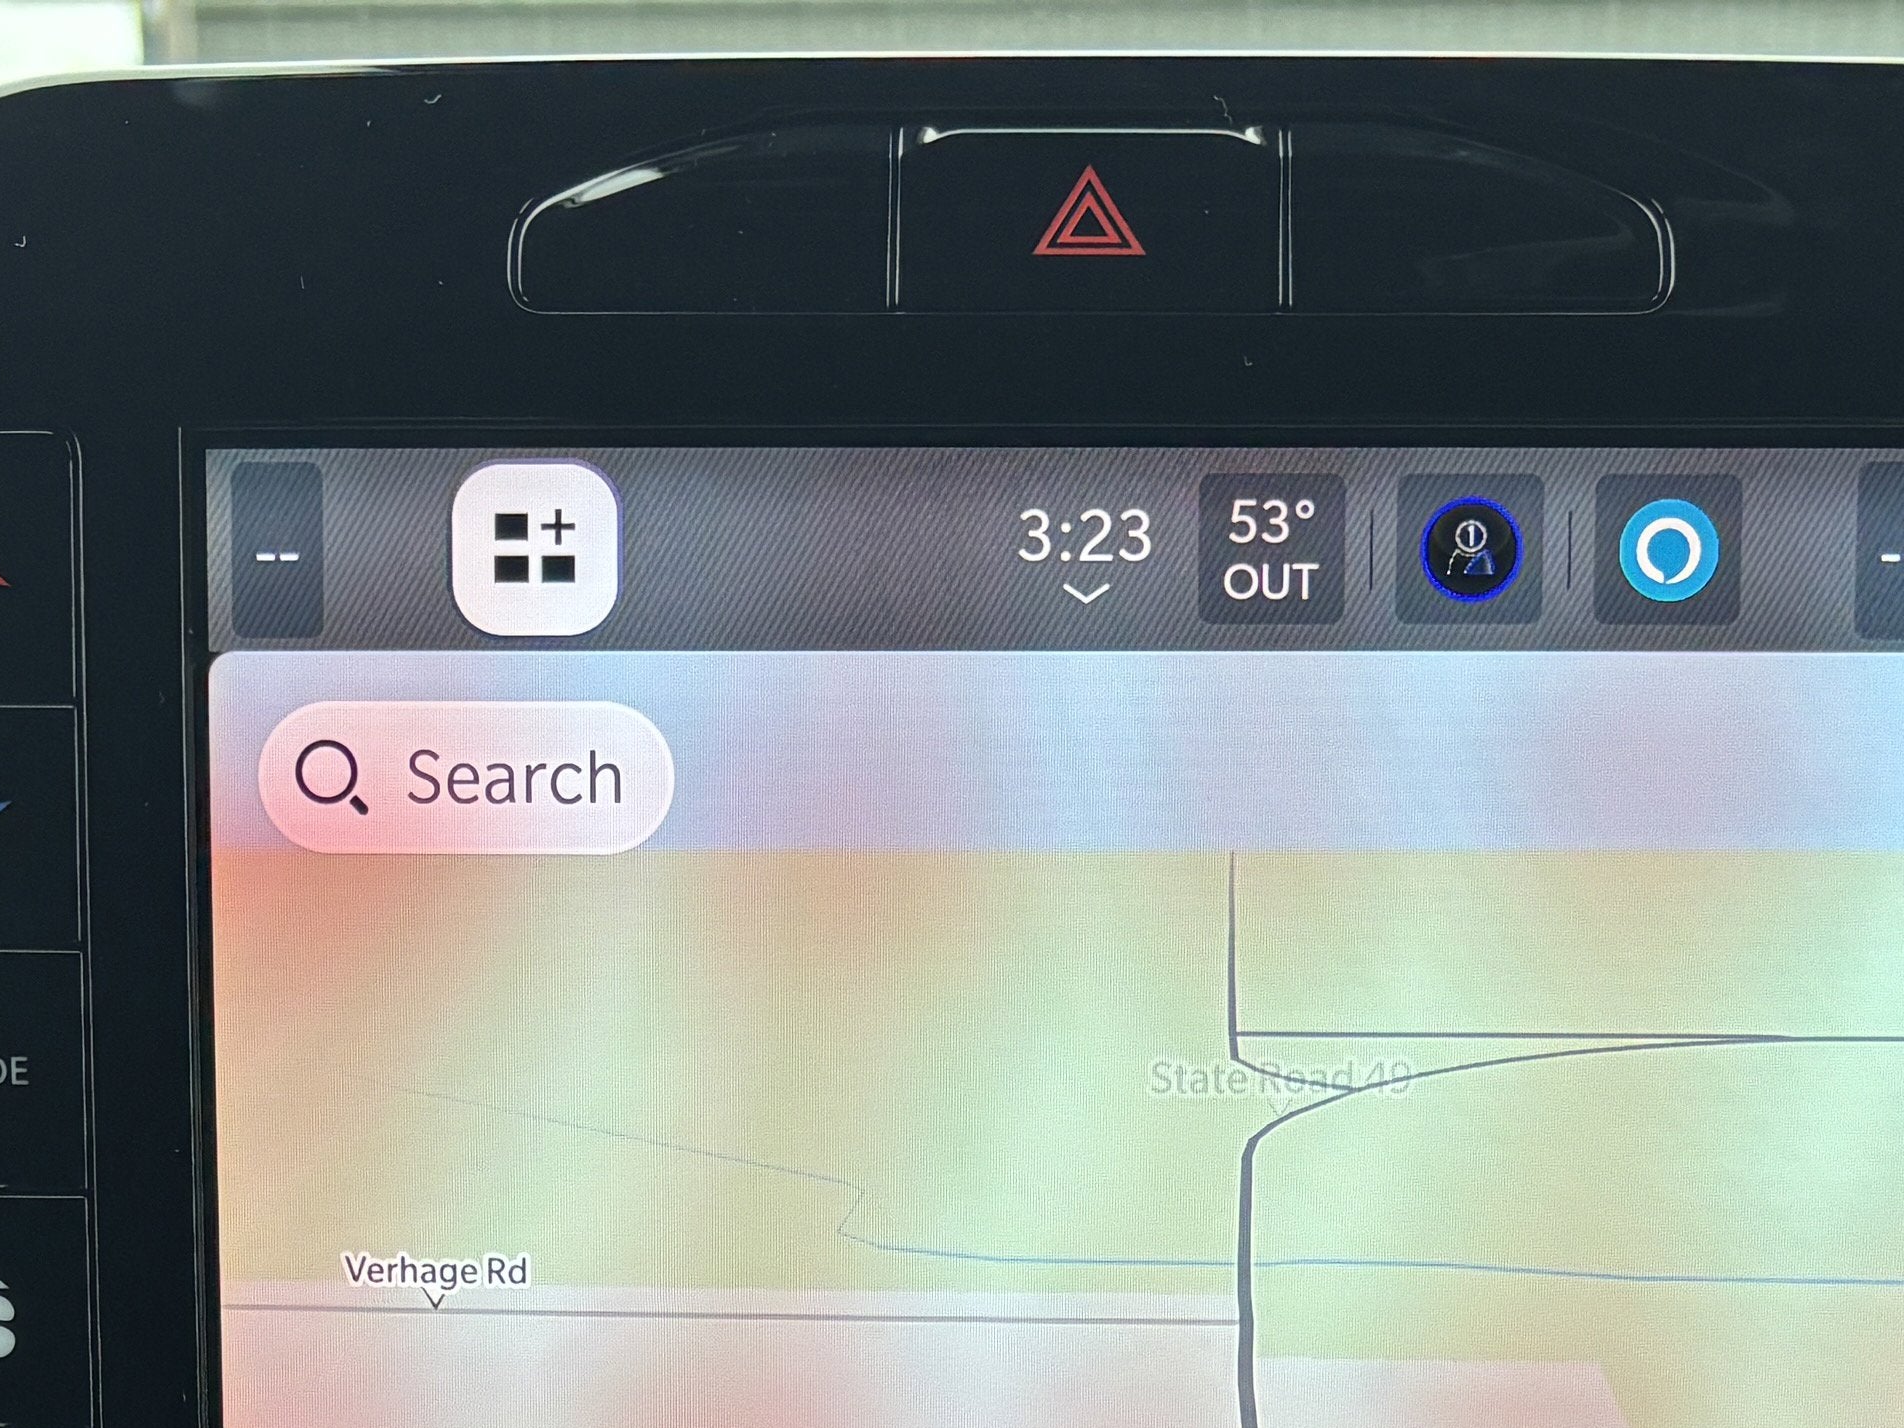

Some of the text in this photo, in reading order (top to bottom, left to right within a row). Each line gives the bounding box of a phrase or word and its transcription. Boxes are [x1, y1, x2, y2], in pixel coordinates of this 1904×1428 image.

[1018, 508, 1152, 562] 3:23
[1228, 496, 1316, 545] 53°
[1224, 562, 1319, 604] OUT
[406, 749, 623, 807] Search
[1151, 1061, 1412, 1095] State Road 49
[345, 1257, 528, 1292] Verhage Rd
